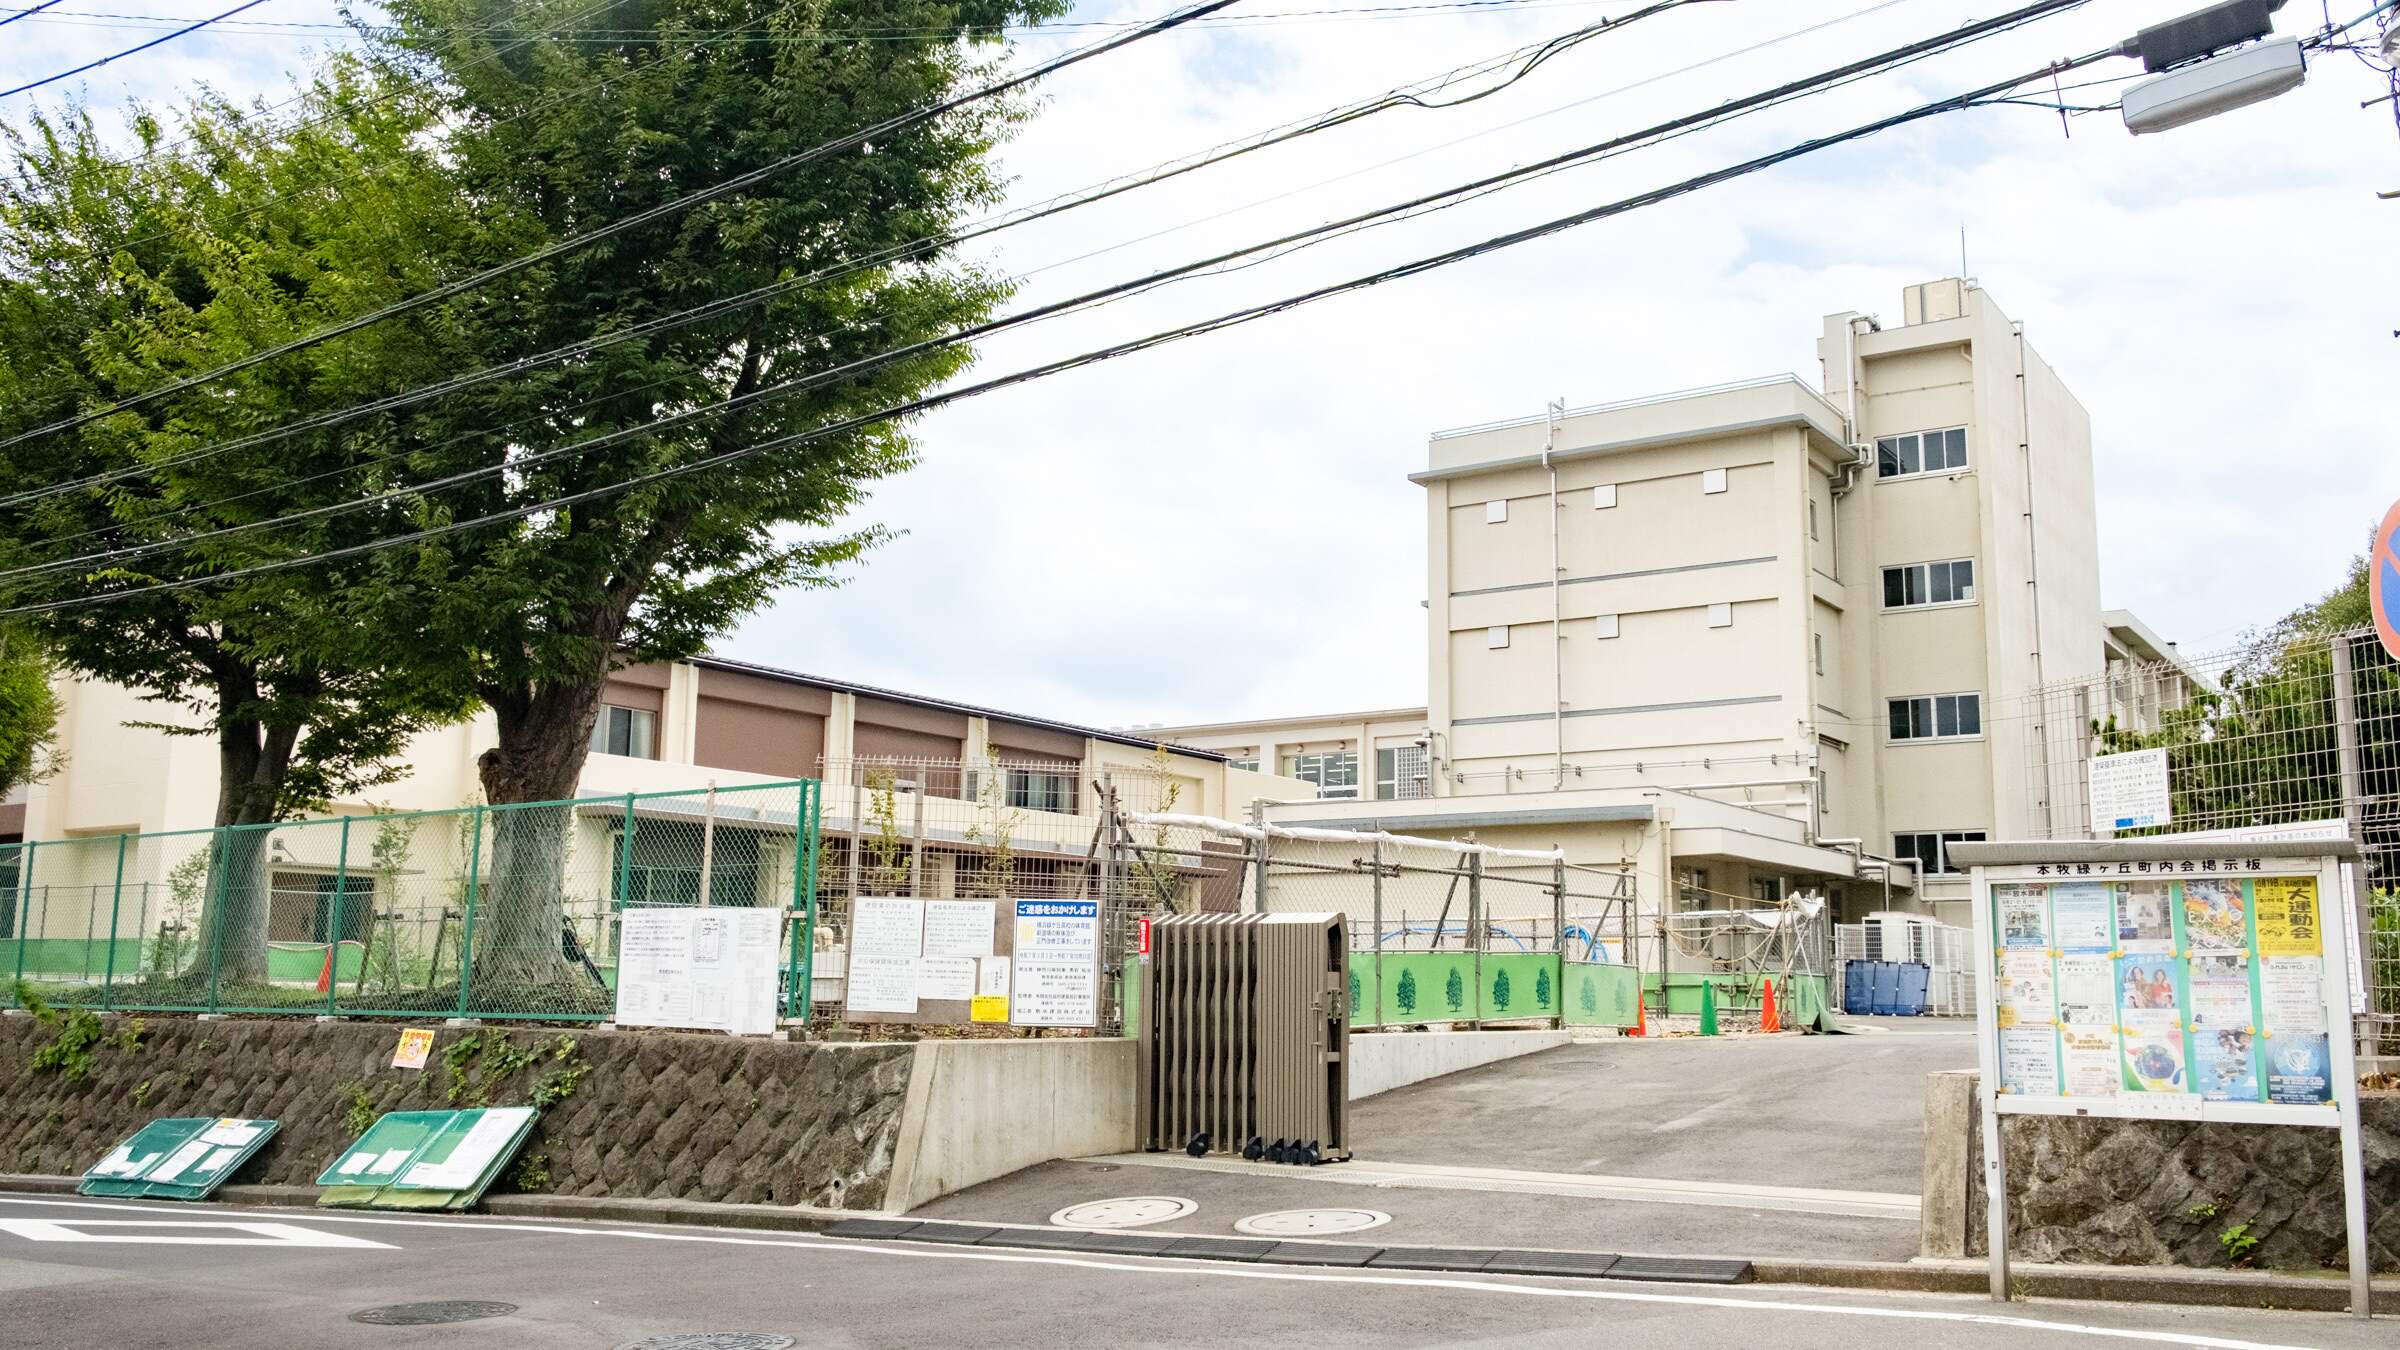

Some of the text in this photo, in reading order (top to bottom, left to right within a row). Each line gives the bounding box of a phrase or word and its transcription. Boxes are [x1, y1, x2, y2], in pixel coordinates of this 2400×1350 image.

[1018, 904, 1096, 916] ご迷惑をおかけします
[2287, 887, 2314, 939] 大運動会
